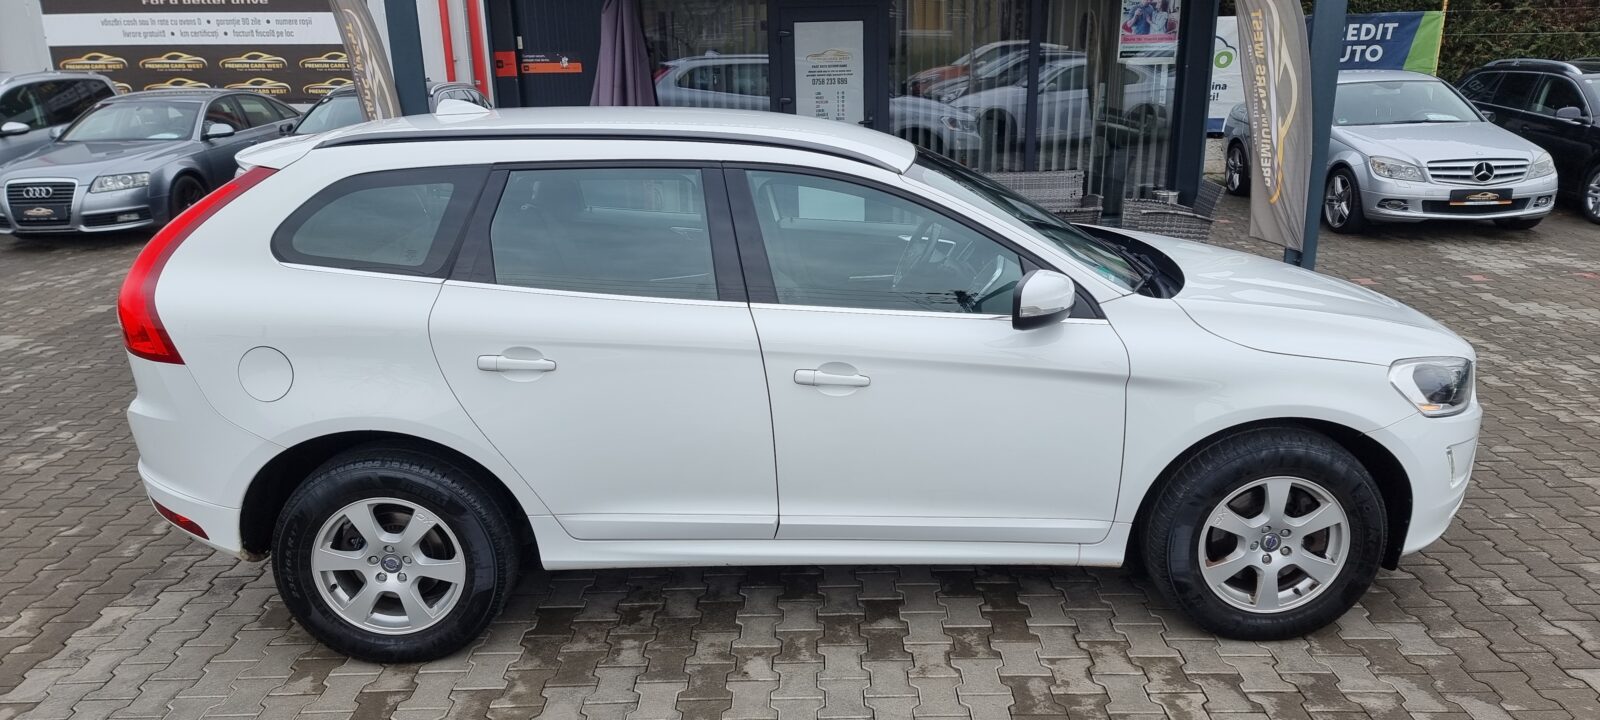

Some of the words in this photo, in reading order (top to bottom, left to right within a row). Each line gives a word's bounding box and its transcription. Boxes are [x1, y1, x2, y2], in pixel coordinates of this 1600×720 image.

[284, 30, 295, 38] loc
[1342, 22, 1399, 41] EDIT
[1339, 44, 1384, 63] UTO
[1211, 81, 1228, 91] ina
